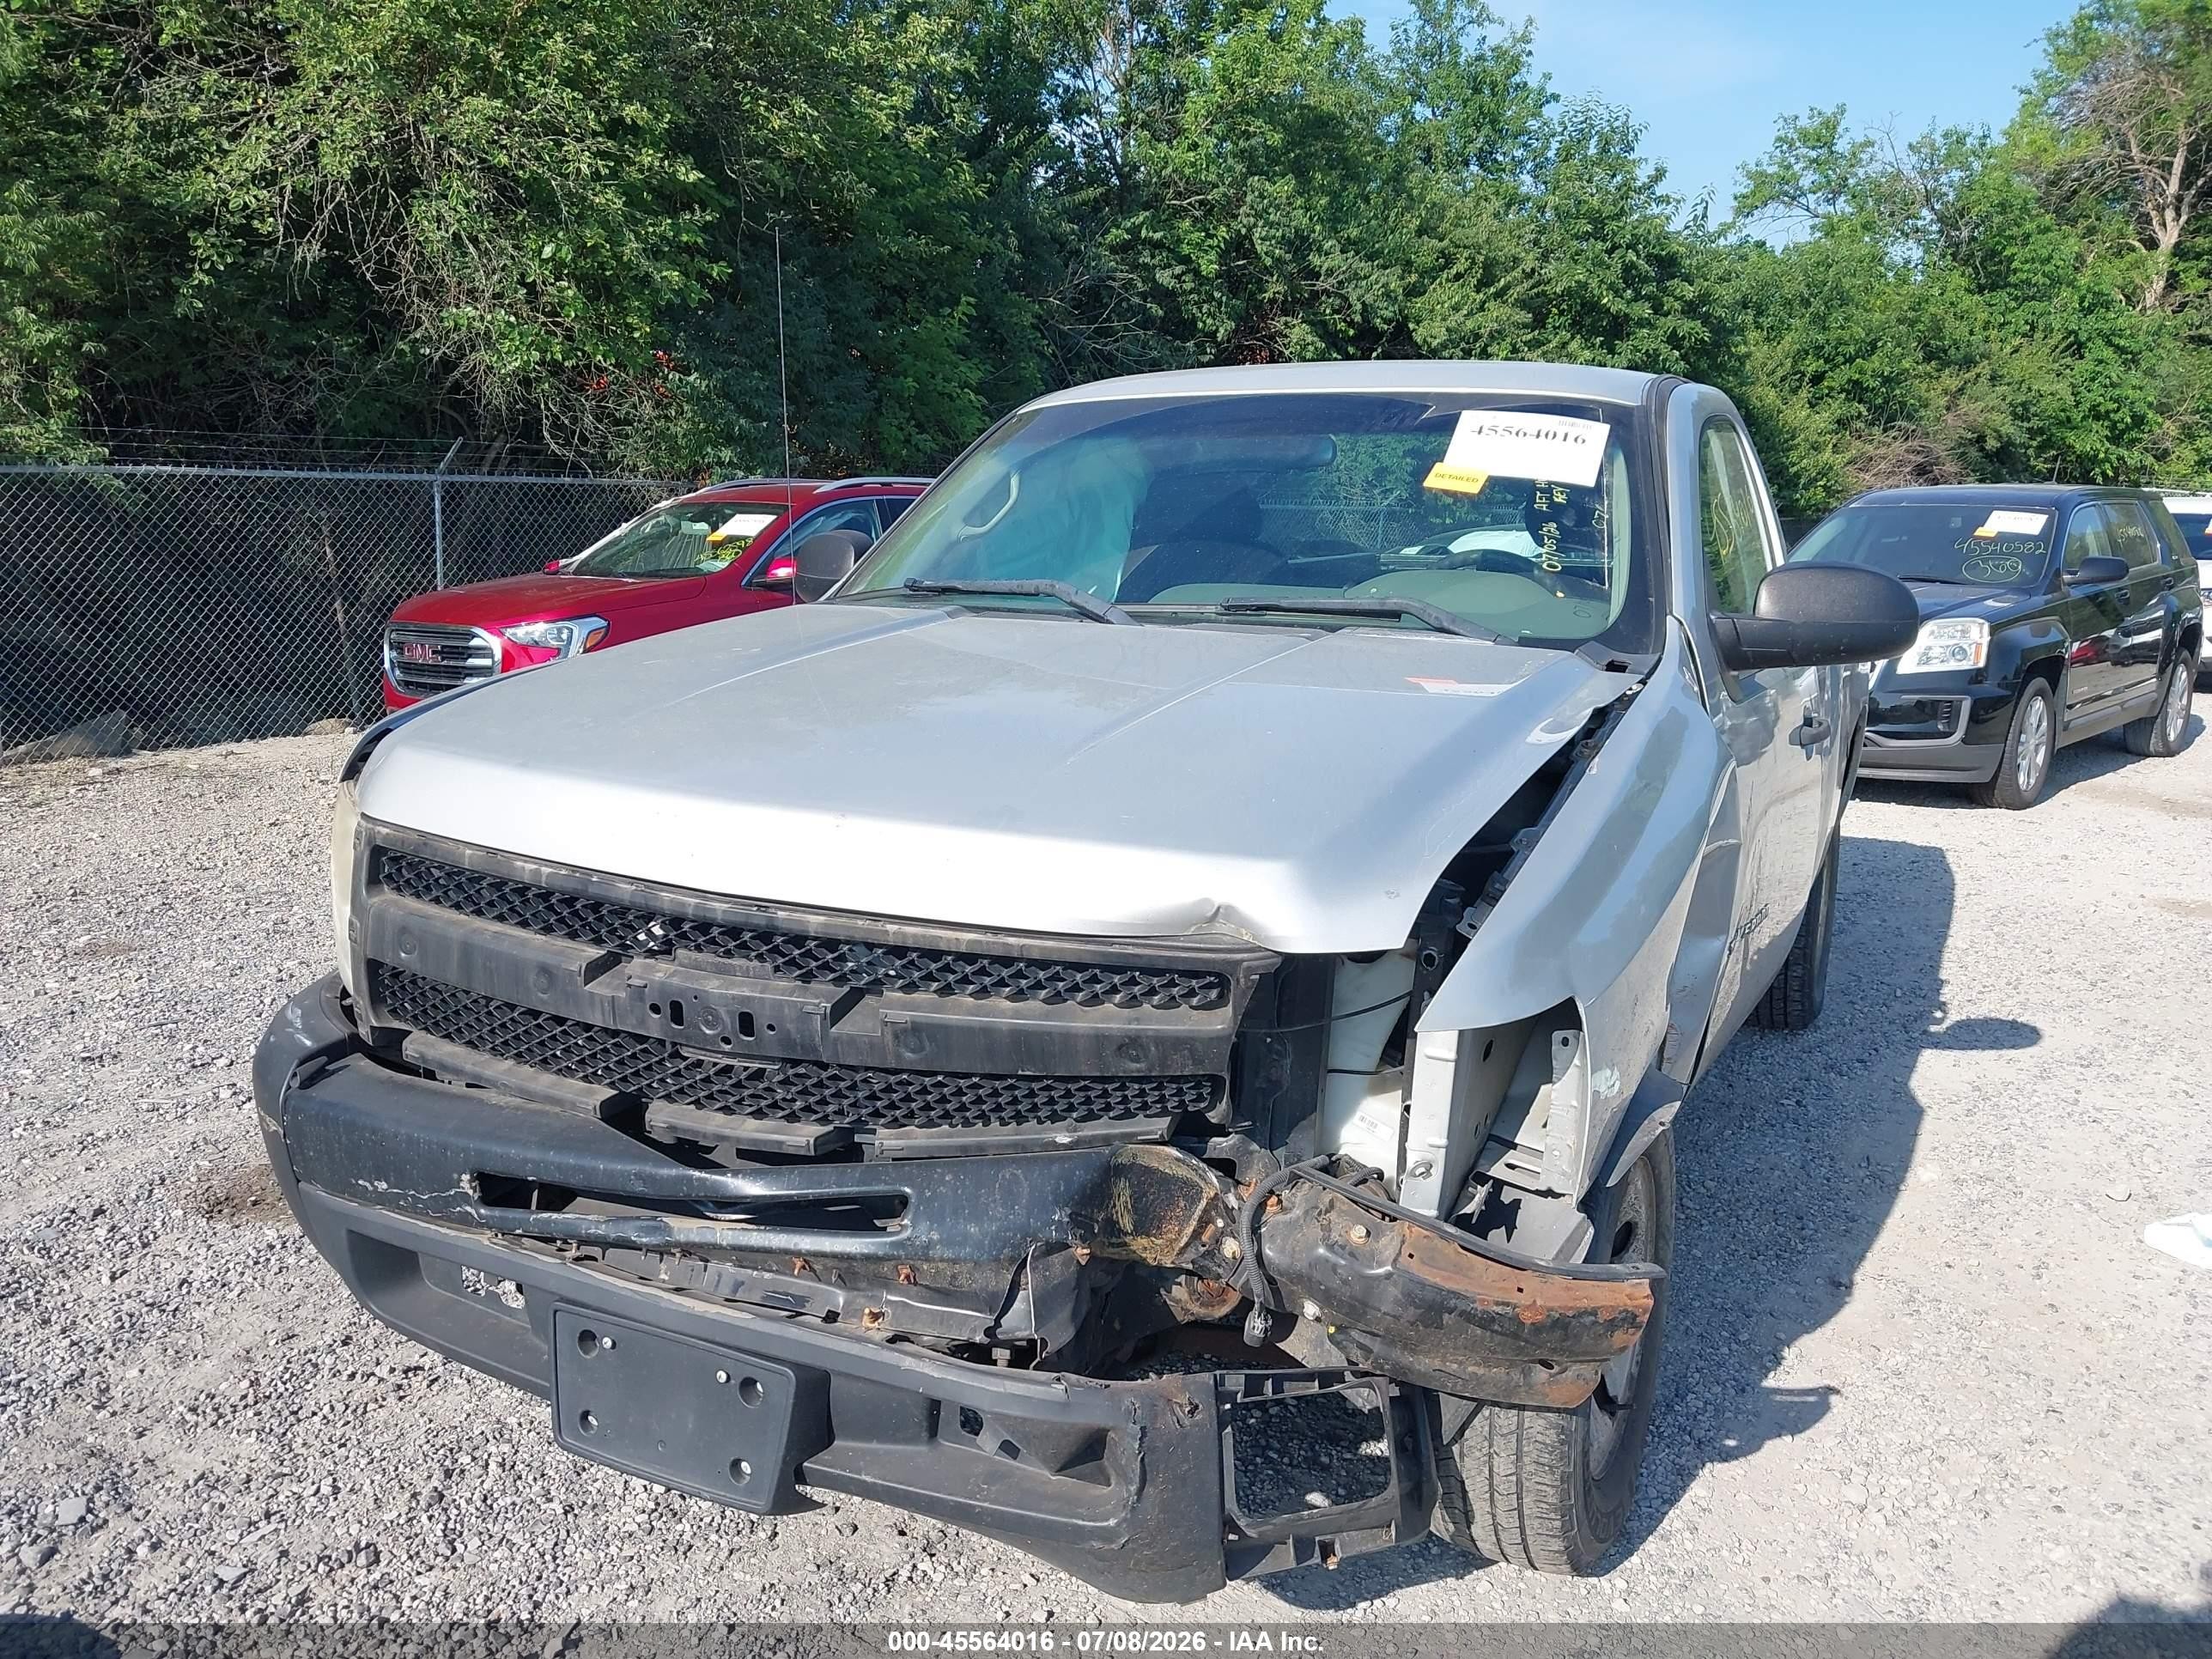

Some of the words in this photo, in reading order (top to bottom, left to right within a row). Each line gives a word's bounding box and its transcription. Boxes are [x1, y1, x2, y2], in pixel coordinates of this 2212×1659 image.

[1470, 424, 1587, 445] 45564016
[1434, 472, 1480, 484] DETAILED
[1954, 537, 2047, 556] 45540582
[404, 642, 441, 662] GMC
